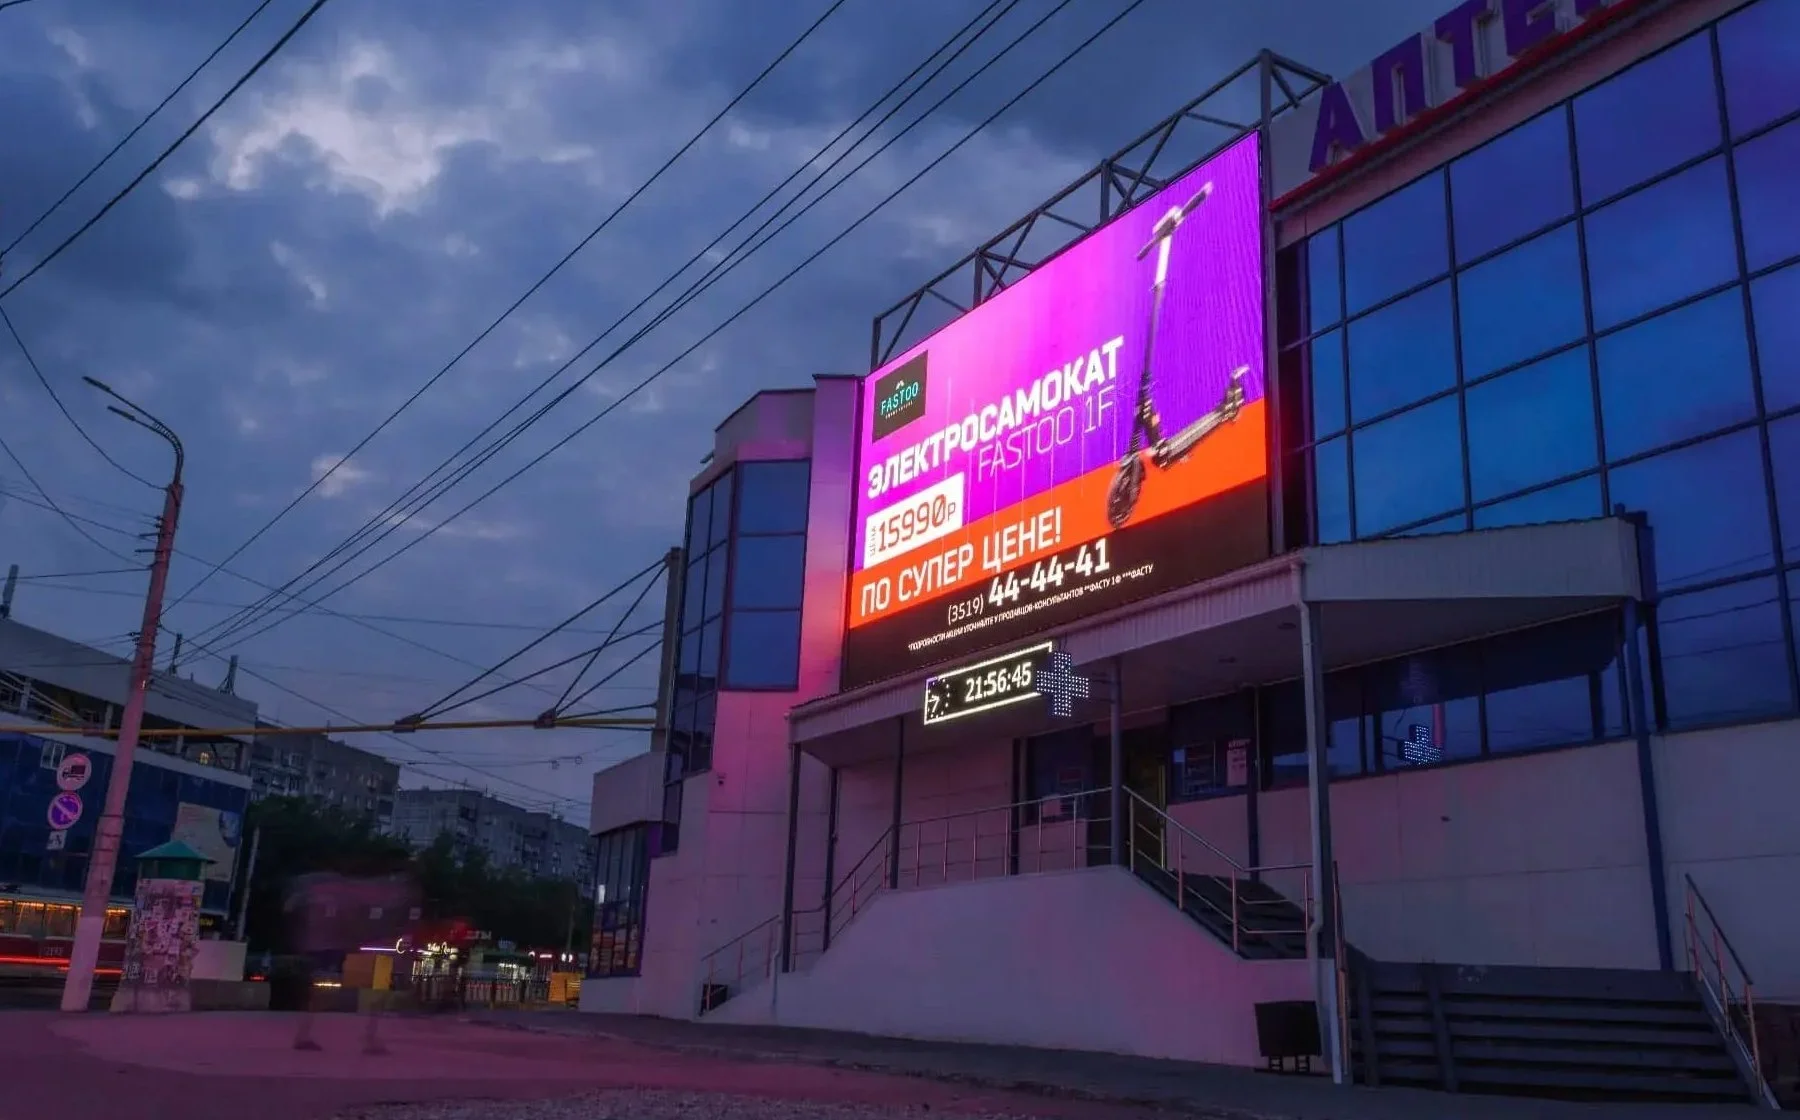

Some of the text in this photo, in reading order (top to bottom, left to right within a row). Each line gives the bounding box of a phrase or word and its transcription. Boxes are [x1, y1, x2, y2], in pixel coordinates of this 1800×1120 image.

[1308, 0, 1608, 175] АПТЕ
[867, 335, 1125, 499] ЭЛЕКТРОСАМОКАТ
[880, 381, 919, 416] FASTOO
[977, 386, 1116, 484] FASTOO 1F
[861, 506, 1062, 617] ПО СУПЕР ЦЕНЕ!
[947, 538, 1110, 626] (3519) 44-44-41
[964, 661, 1032, 702] 21:56:45
